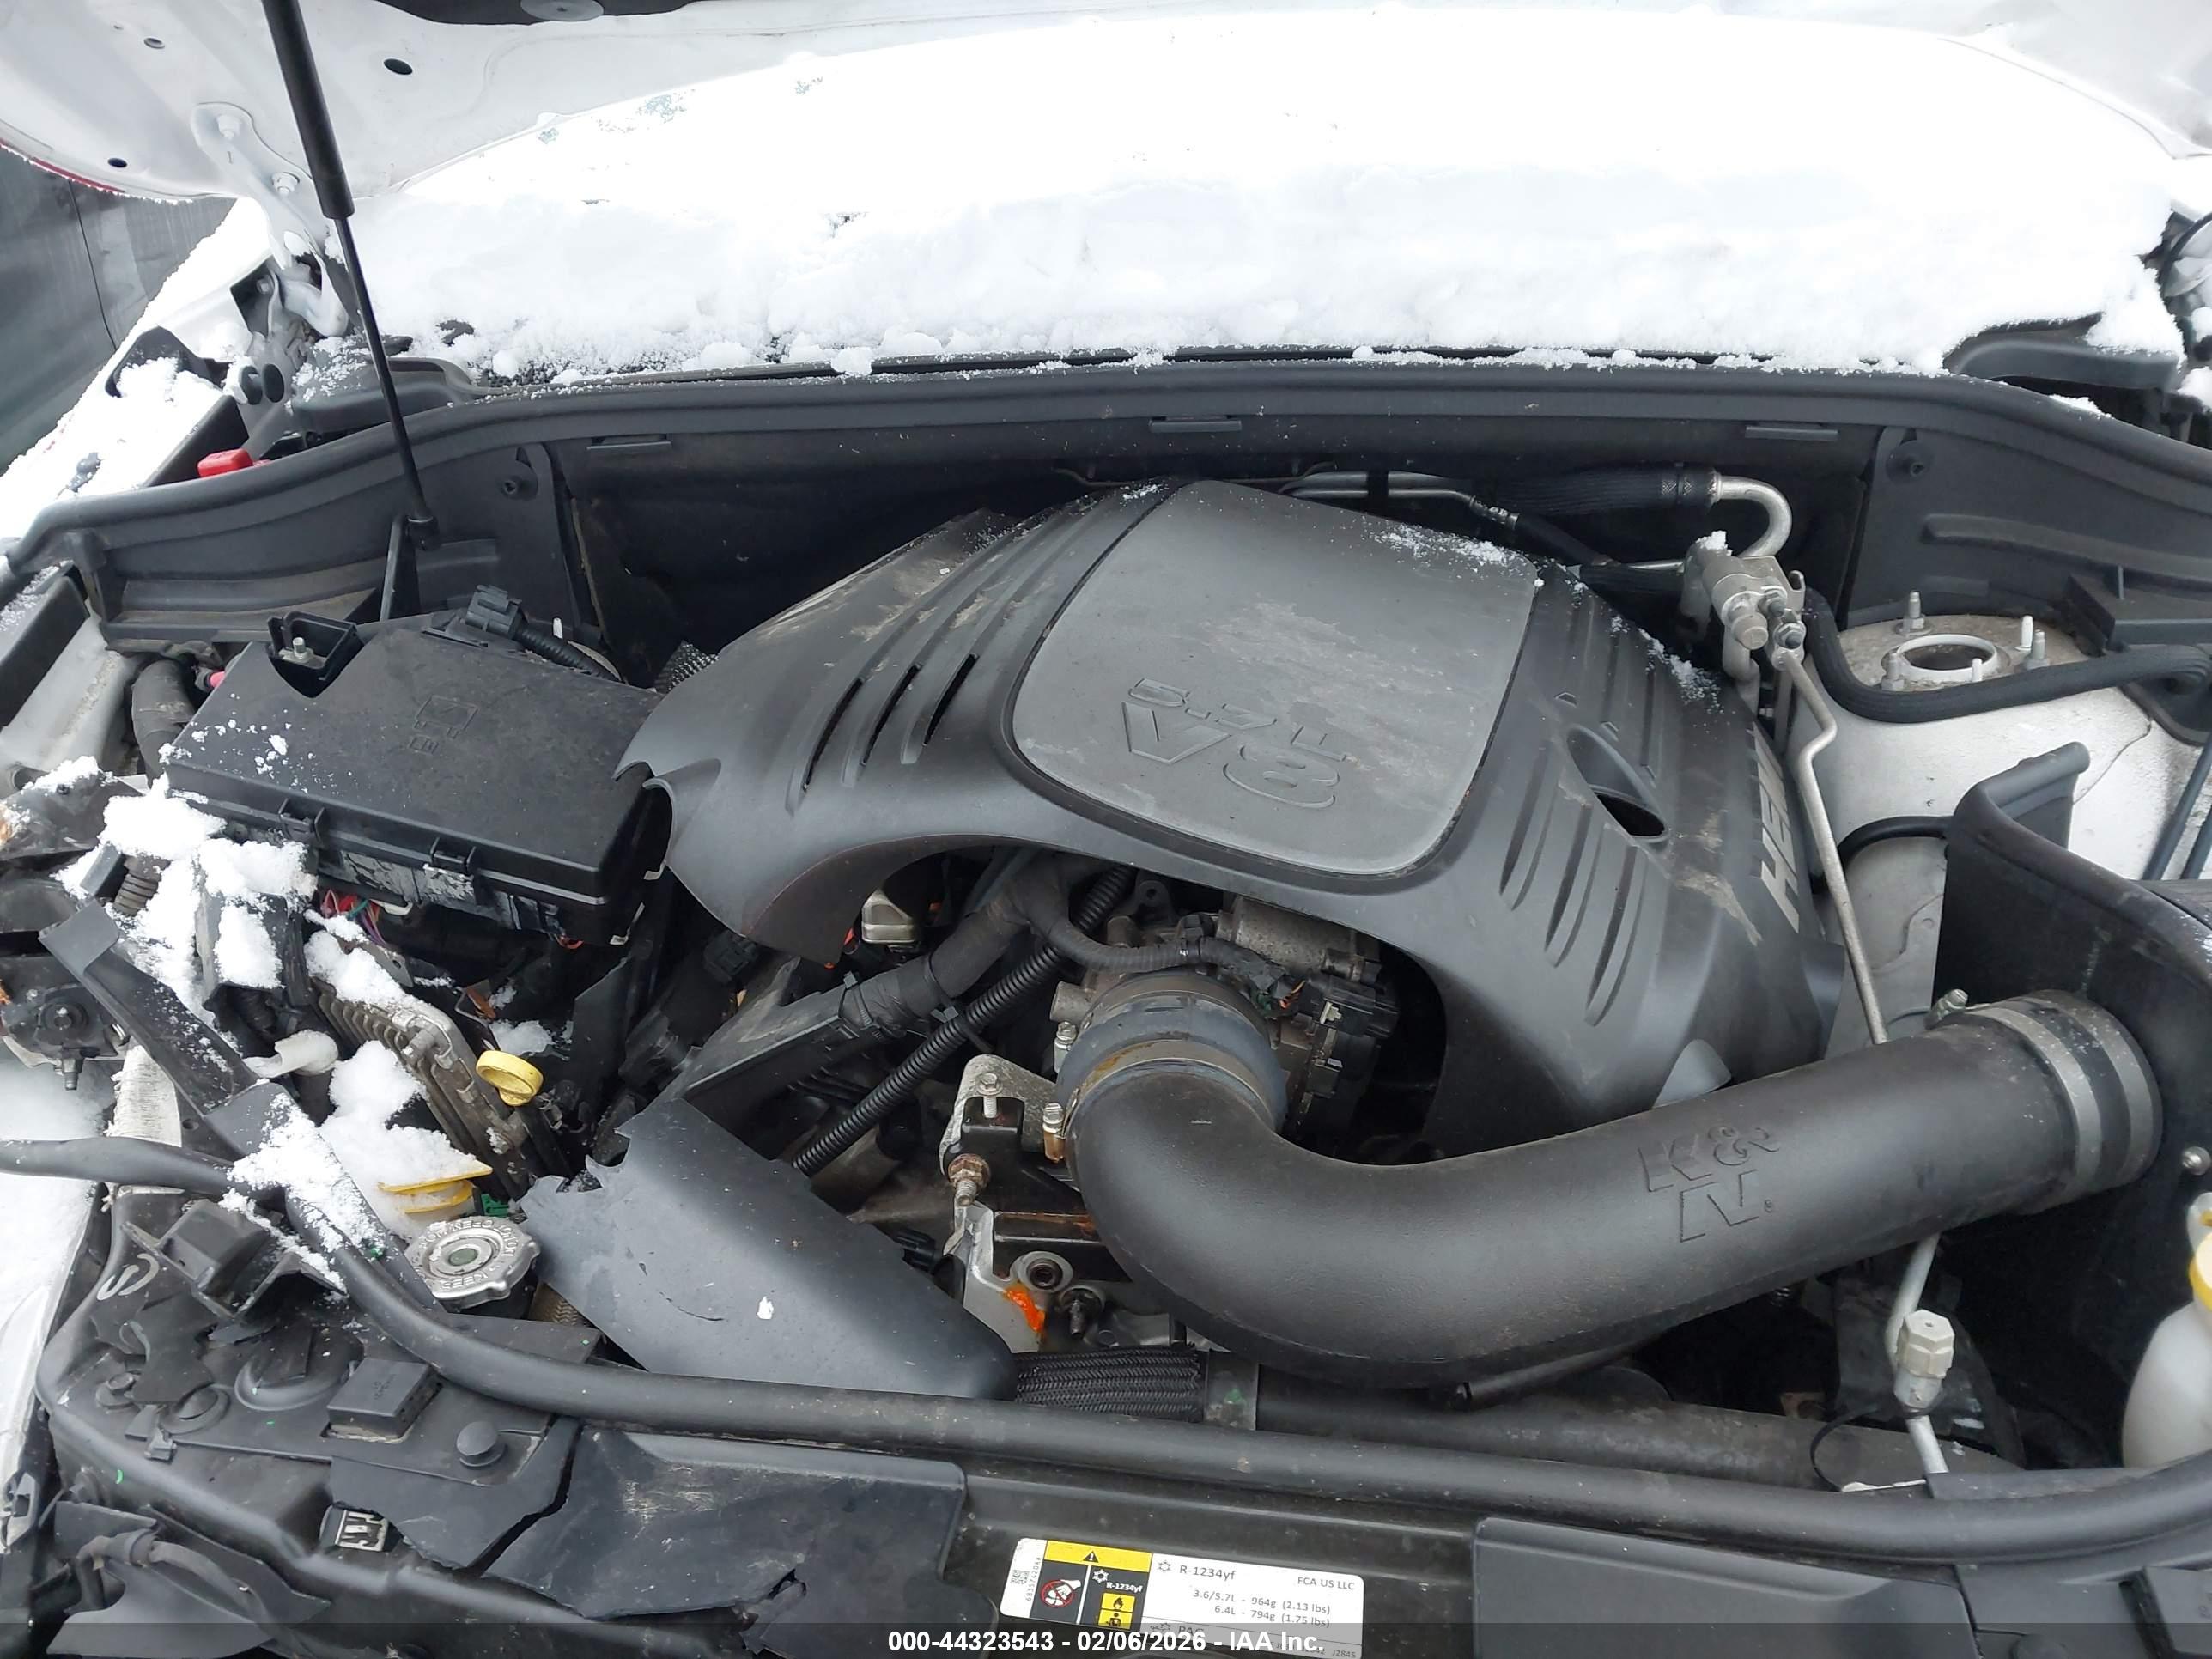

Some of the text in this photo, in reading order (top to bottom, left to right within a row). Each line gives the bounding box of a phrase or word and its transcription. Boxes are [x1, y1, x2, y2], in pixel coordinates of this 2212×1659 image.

[1121, 699, 1340, 809] V8
[1180, 1565, 1236, 1582] R-1234yf
[1106, 1582, 1144, 1594] R-1234yf
[1297, 1577, 1355, 1591] FCA US LLC
[1194, 1589, 1237, 1603] 3.6/5.7L
[1251, 1596, 1277, 1609] 964g
[1282, 1600, 1309, 1613] (2.13
[1311, 1603, 1331, 1615] lbs)
[1214, 1605, 1237, 1616] 6.4L
[1251, 1609, 1276, 1622] 794g
[1281, 1613, 1308, 1626] (1.75
[1310, 1616, 1330, 1629] lbs)
[1332, 1649, 1357, 1659] J2845
